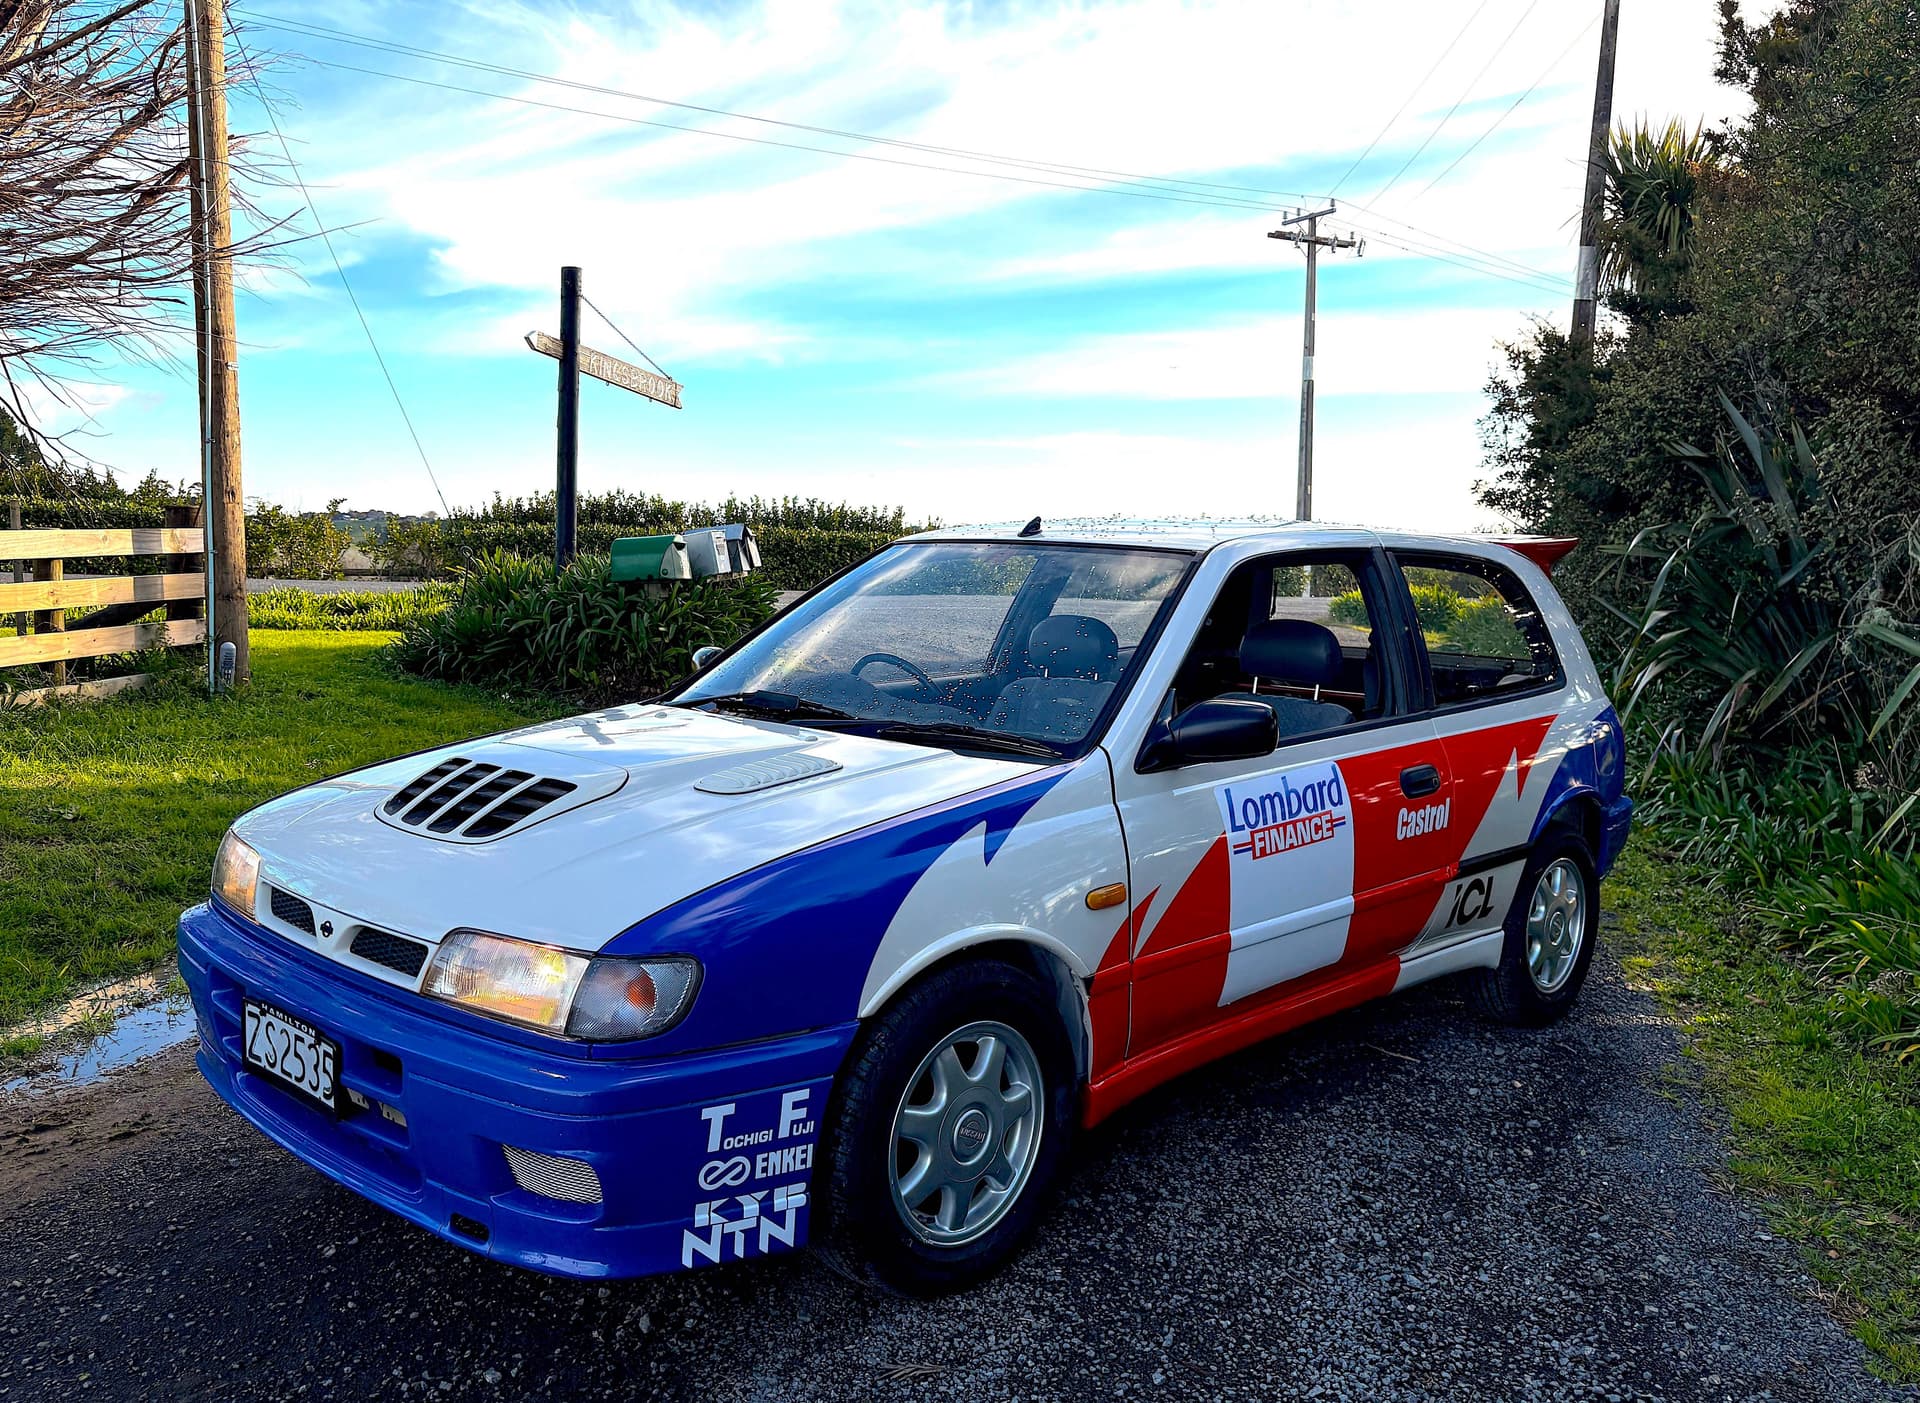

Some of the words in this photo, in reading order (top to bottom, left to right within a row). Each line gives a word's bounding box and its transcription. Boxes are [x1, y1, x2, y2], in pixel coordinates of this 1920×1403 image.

[590, 354, 672, 401] KINGSBROOK
[1224, 764, 1343, 832] Lombard
[1397, 797, 1450, 840] Castrol
[1254, 814, 1332, 857] FINANCE
[1445, 876, 1494, 928] ICL
[262, 1004, 315, 1036] HAMILTON
[248, 1011, 333, 1099] ZS2535
[701, 1103, 773, 1152] TOCHIGI
[778, 1088, 814, 1138] FUJI
[755, 1143, 813, 1179] ENKEI
[694, 1182, 807, 1228] KYB
[682, 1207, 796, 1268] NTN
